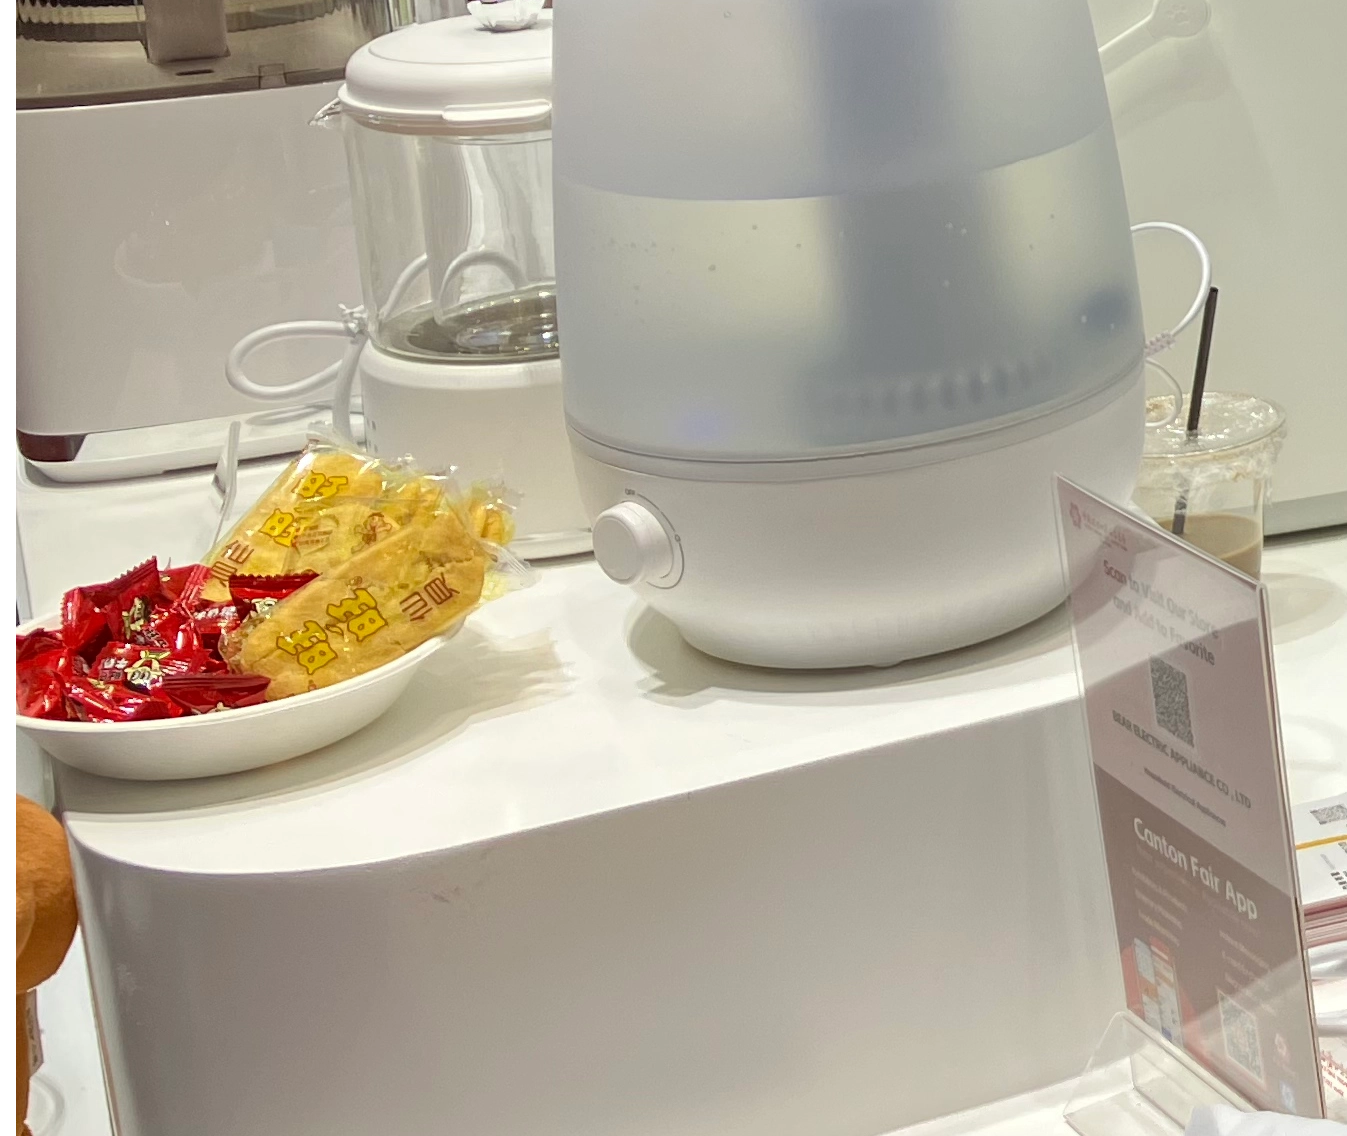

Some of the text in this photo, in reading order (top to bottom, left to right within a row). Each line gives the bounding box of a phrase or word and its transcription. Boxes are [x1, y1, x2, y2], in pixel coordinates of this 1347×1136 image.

[1103, 559, 1128, 586] Scan
[1112, 595, 1132, 616] and
[1169, 627, 1215, 666] Favorite
[1134, 817, 1188, 871] Canton
[1190, 855, 1221, 894] Fair
[1225, 879, 1258, 920] App
